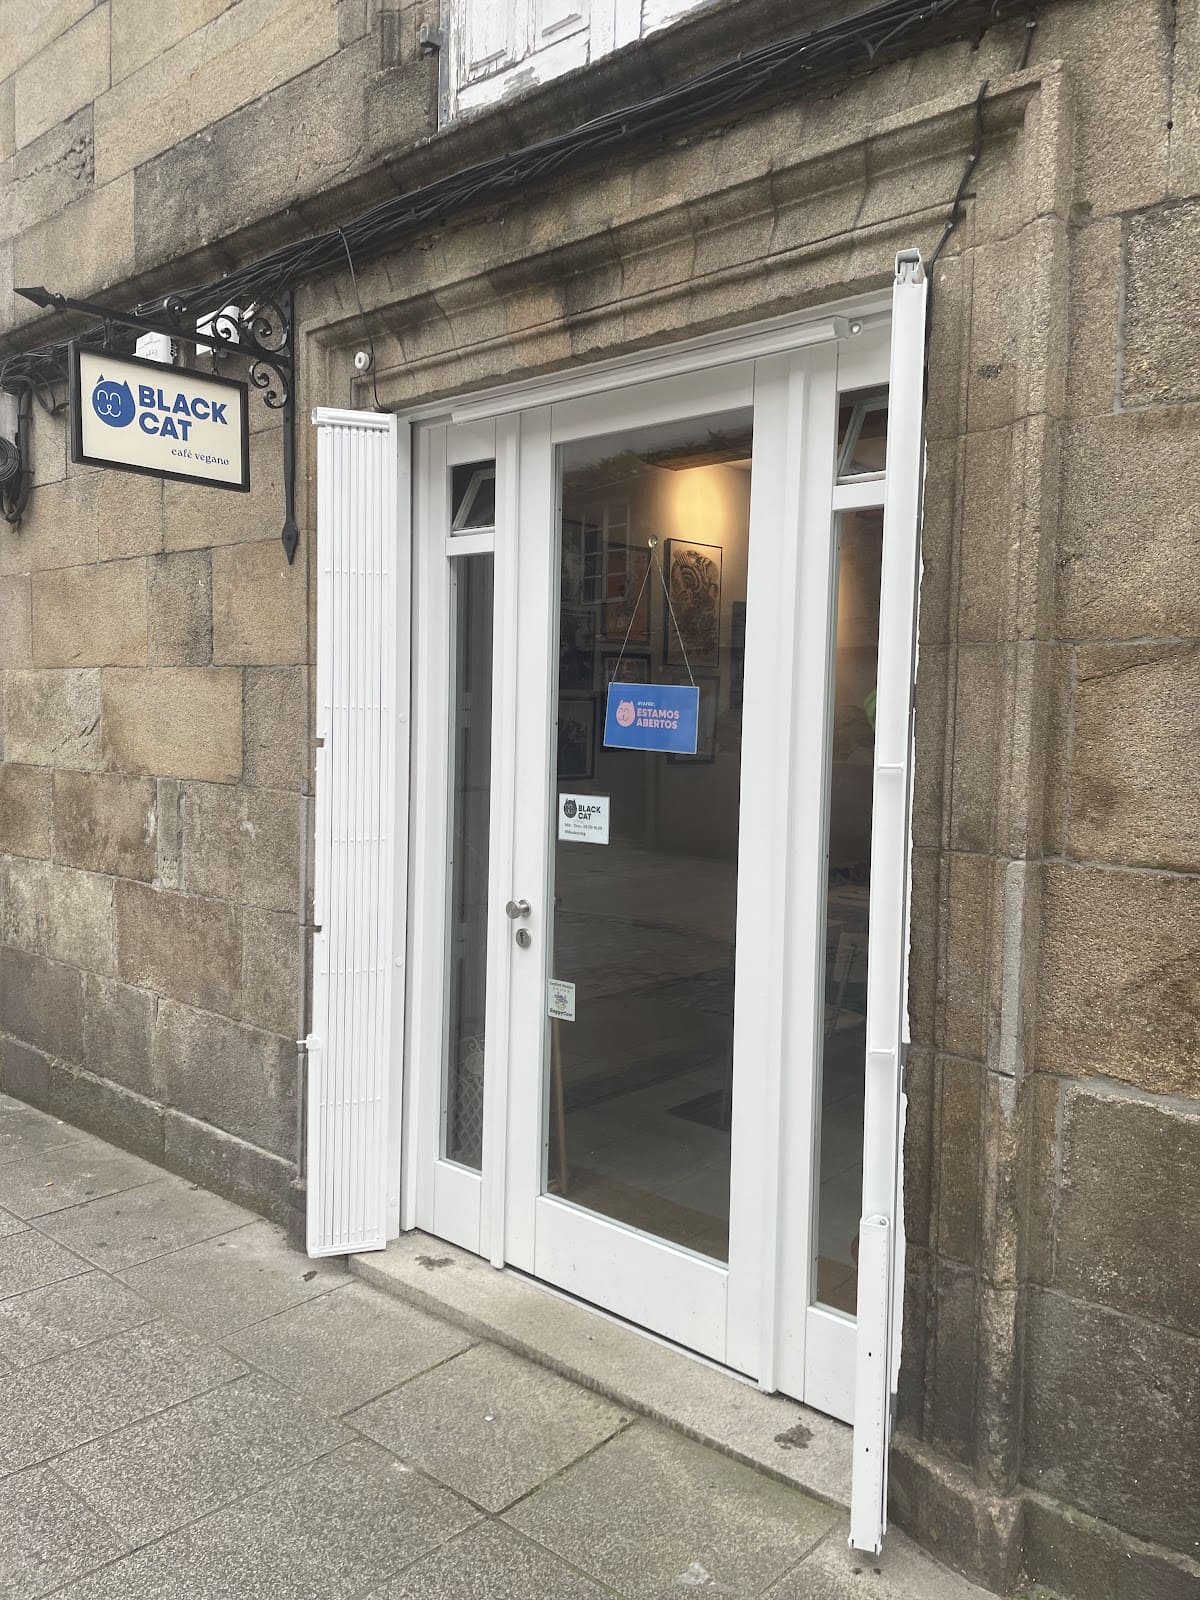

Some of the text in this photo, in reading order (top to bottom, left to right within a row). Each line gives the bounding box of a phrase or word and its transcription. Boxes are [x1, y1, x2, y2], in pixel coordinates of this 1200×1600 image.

[138, 384, 228, 425] BLACK
[138, 411, 193, 441] CAT
[171, 448, 230, 466] café vegano
[636, 708, 680, 720] ESTAMOS
[636, 719, 678, 730] ABERTOS
[578, 804, 601, 814] BLACK
[578, 812, 592, 821] CAT
